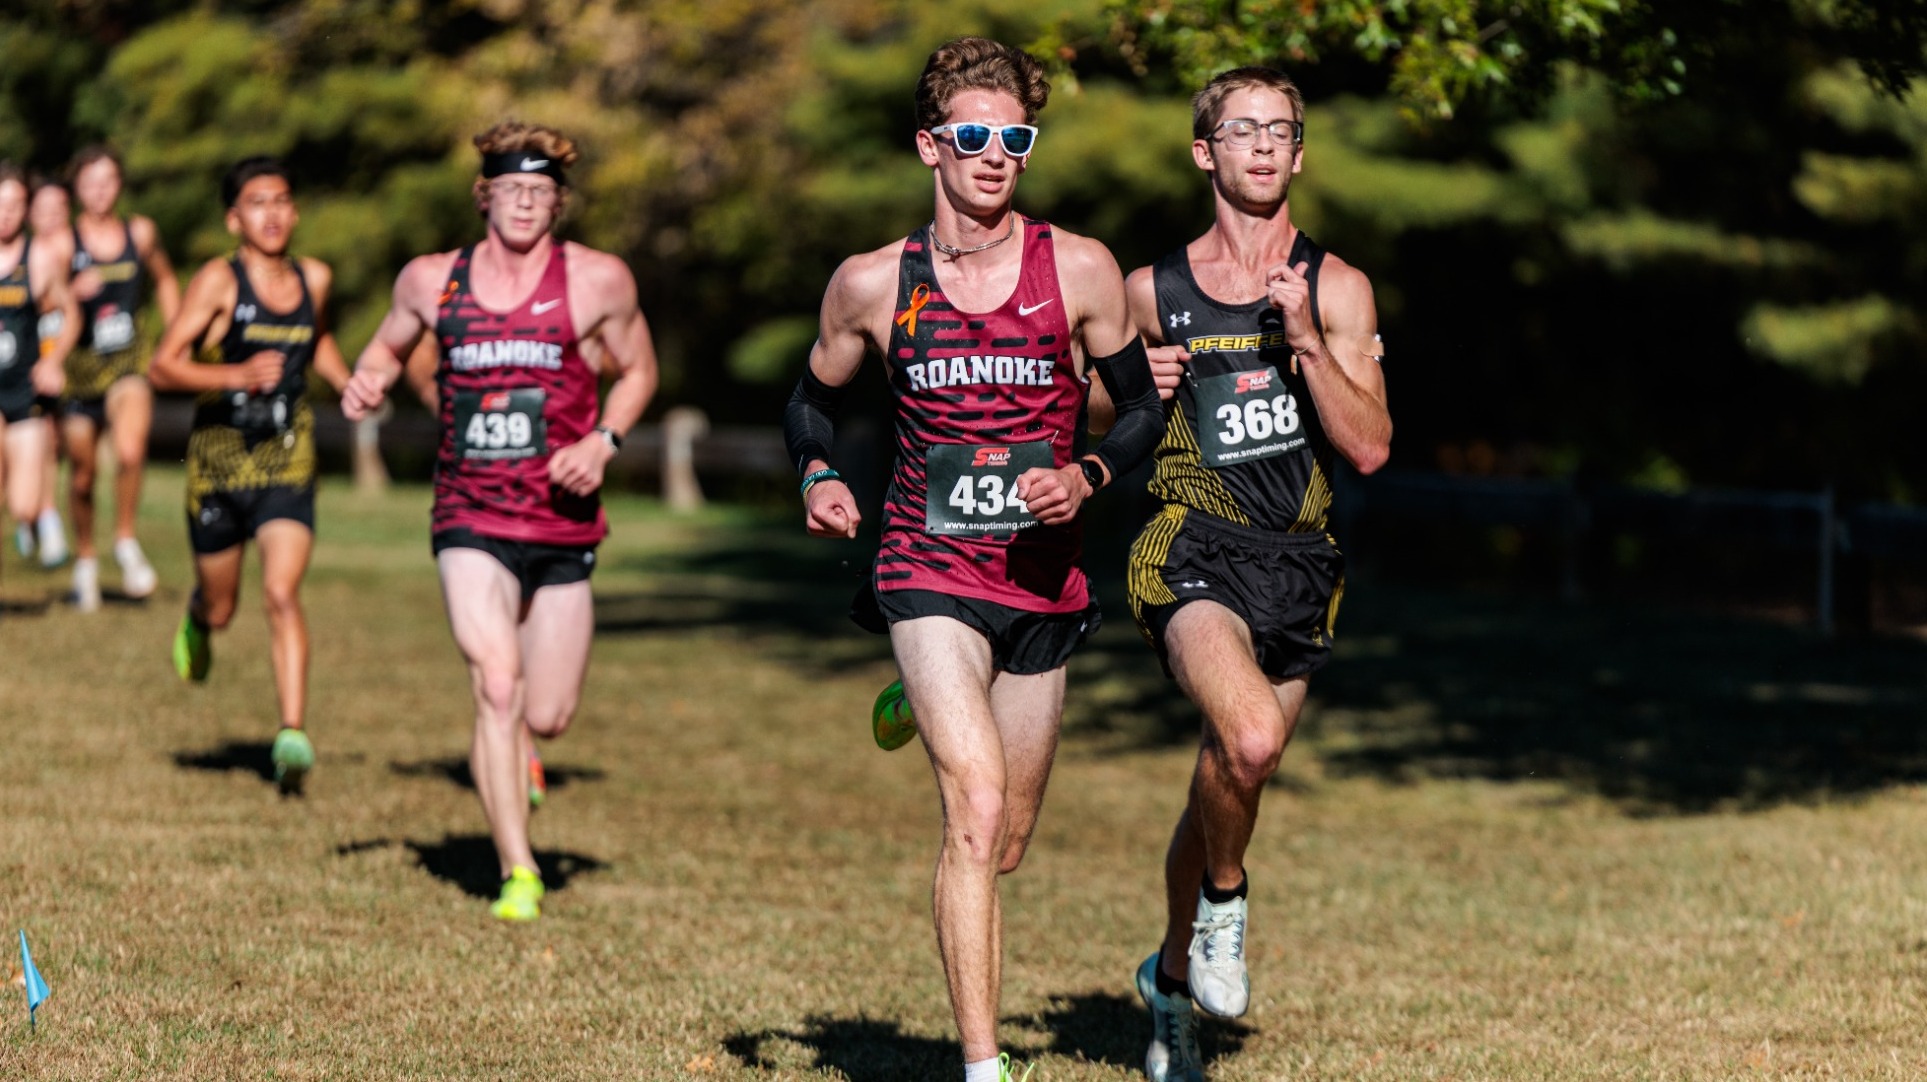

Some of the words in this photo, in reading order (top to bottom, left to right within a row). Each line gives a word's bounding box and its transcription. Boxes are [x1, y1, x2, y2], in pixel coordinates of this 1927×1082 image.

[449, 340, 563, 370] ROANOKE
[1188, 333, 1286, 354] PFEIFFE
[906, 355, 1056, 391] ROANOKE
[1235, 370, 1272, 393] SNAP
[465, 411, 532, 448] 439
[1216, 394, 1300, 445] 368
[971, 447, 1011, 467] SNAP
[1217, 437, 1306, 461] www.snaptiming.com
[944, 520, 1039, 532] www.snaptiming.com
